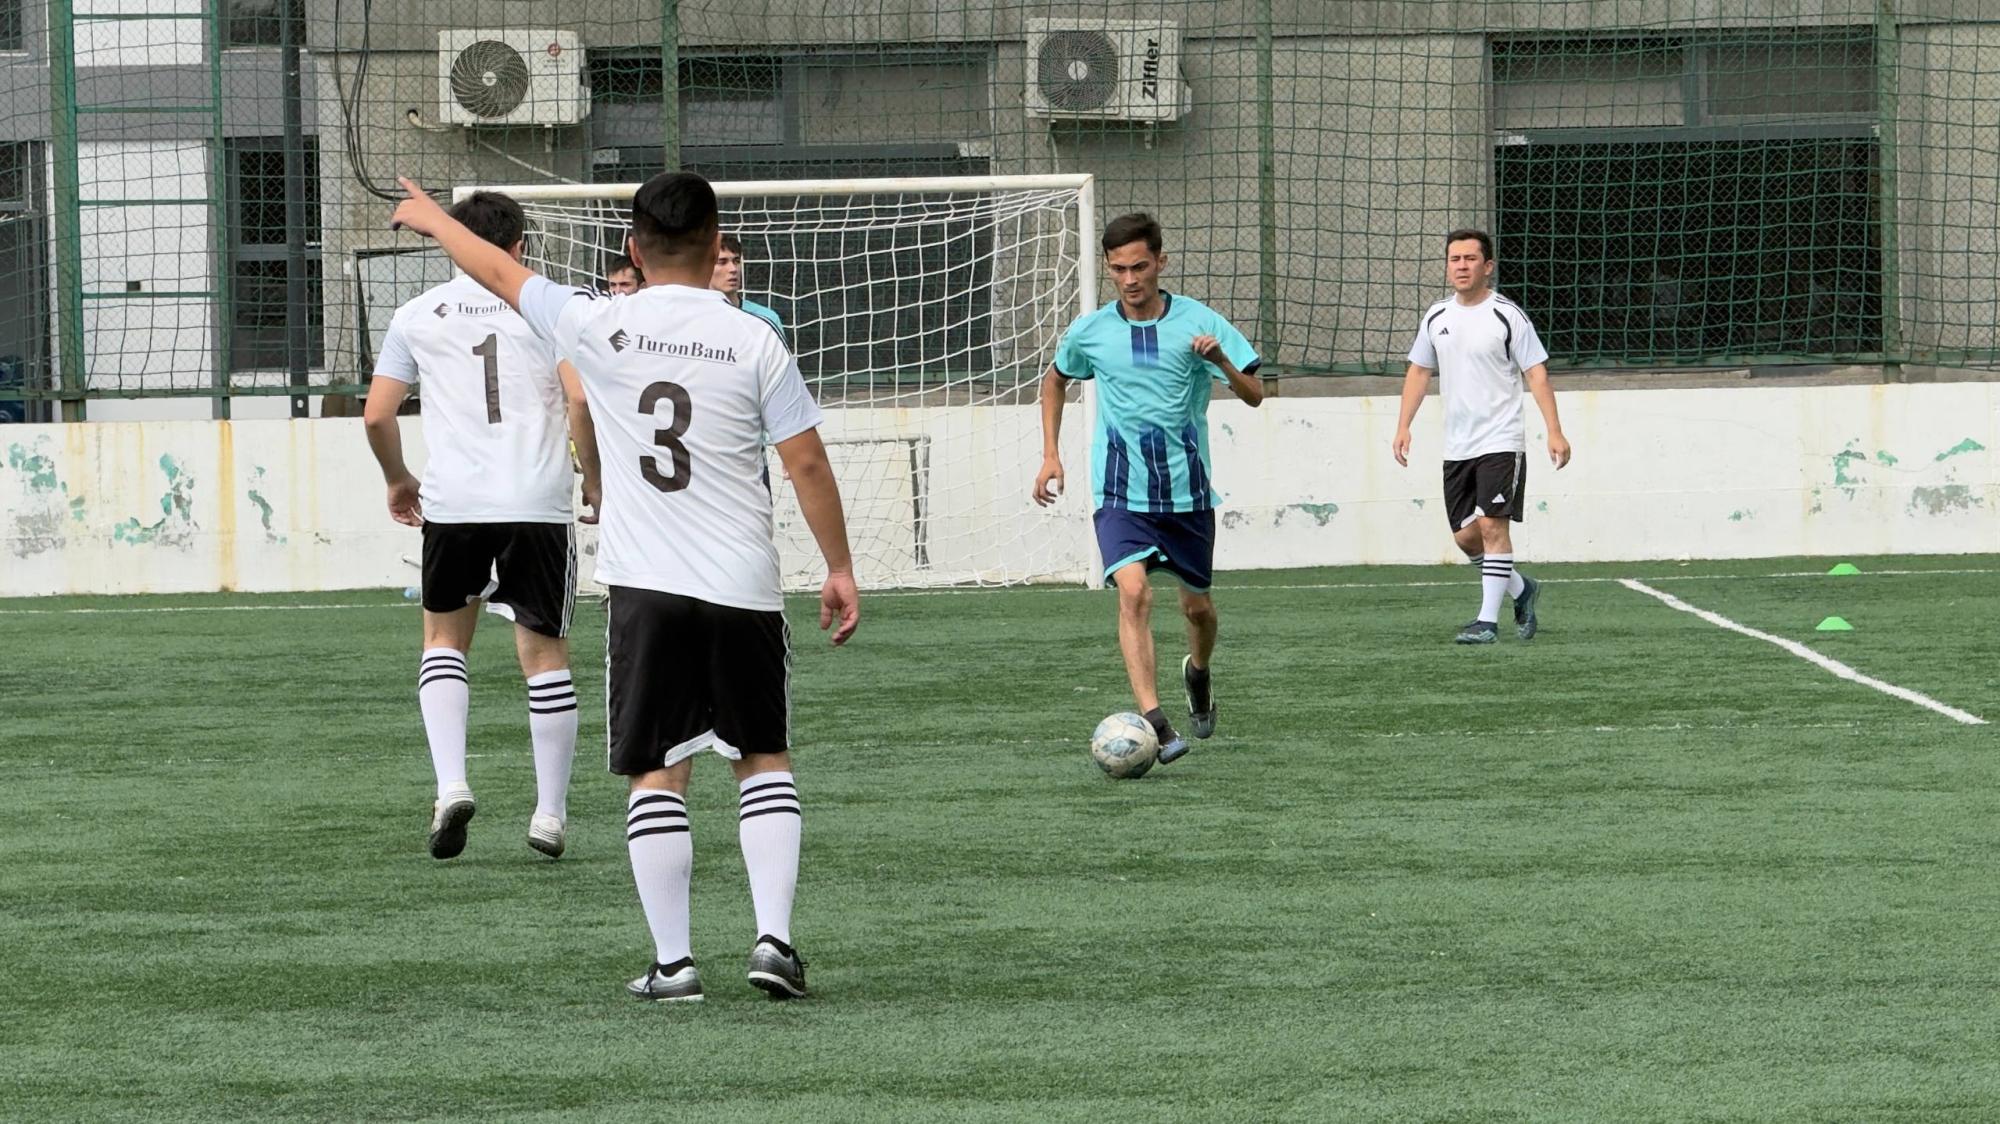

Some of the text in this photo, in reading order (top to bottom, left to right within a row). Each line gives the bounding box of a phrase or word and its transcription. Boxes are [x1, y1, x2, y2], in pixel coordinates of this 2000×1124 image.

[1142, 38, 1159, 99] Ziffler
[455, 301, 513, 315] TuronB
[472, 333, 502, 424] 1
[635, 334, 737, 363] TuronBank
[638, 381, 692, 493] 3
